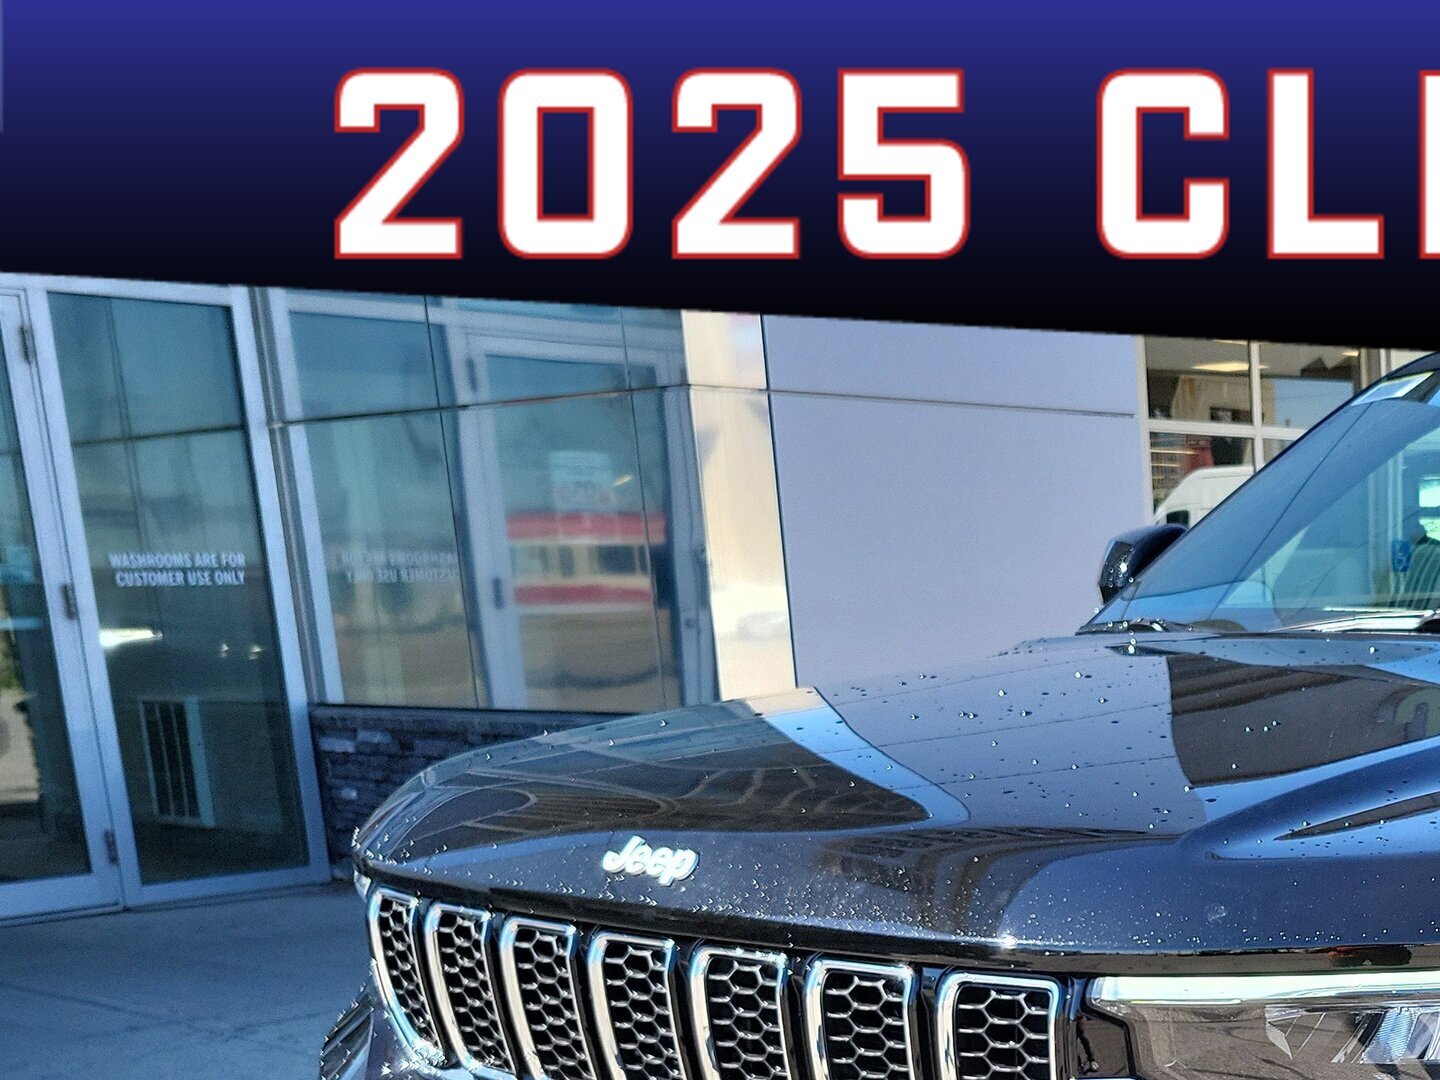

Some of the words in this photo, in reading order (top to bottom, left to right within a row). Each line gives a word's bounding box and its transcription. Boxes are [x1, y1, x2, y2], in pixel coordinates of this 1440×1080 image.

[109, 552, 192, 568] WASHROOMS
[195, 552, 219, 567] ARE
[221, 552, 246, 568] FOR
[115, 570, 184, 587] CUSTOMER
[186, 570, 213, 586] USE
[214, 570, 245, 585] ONLY
[602, 835, 699, 886] Jeep
